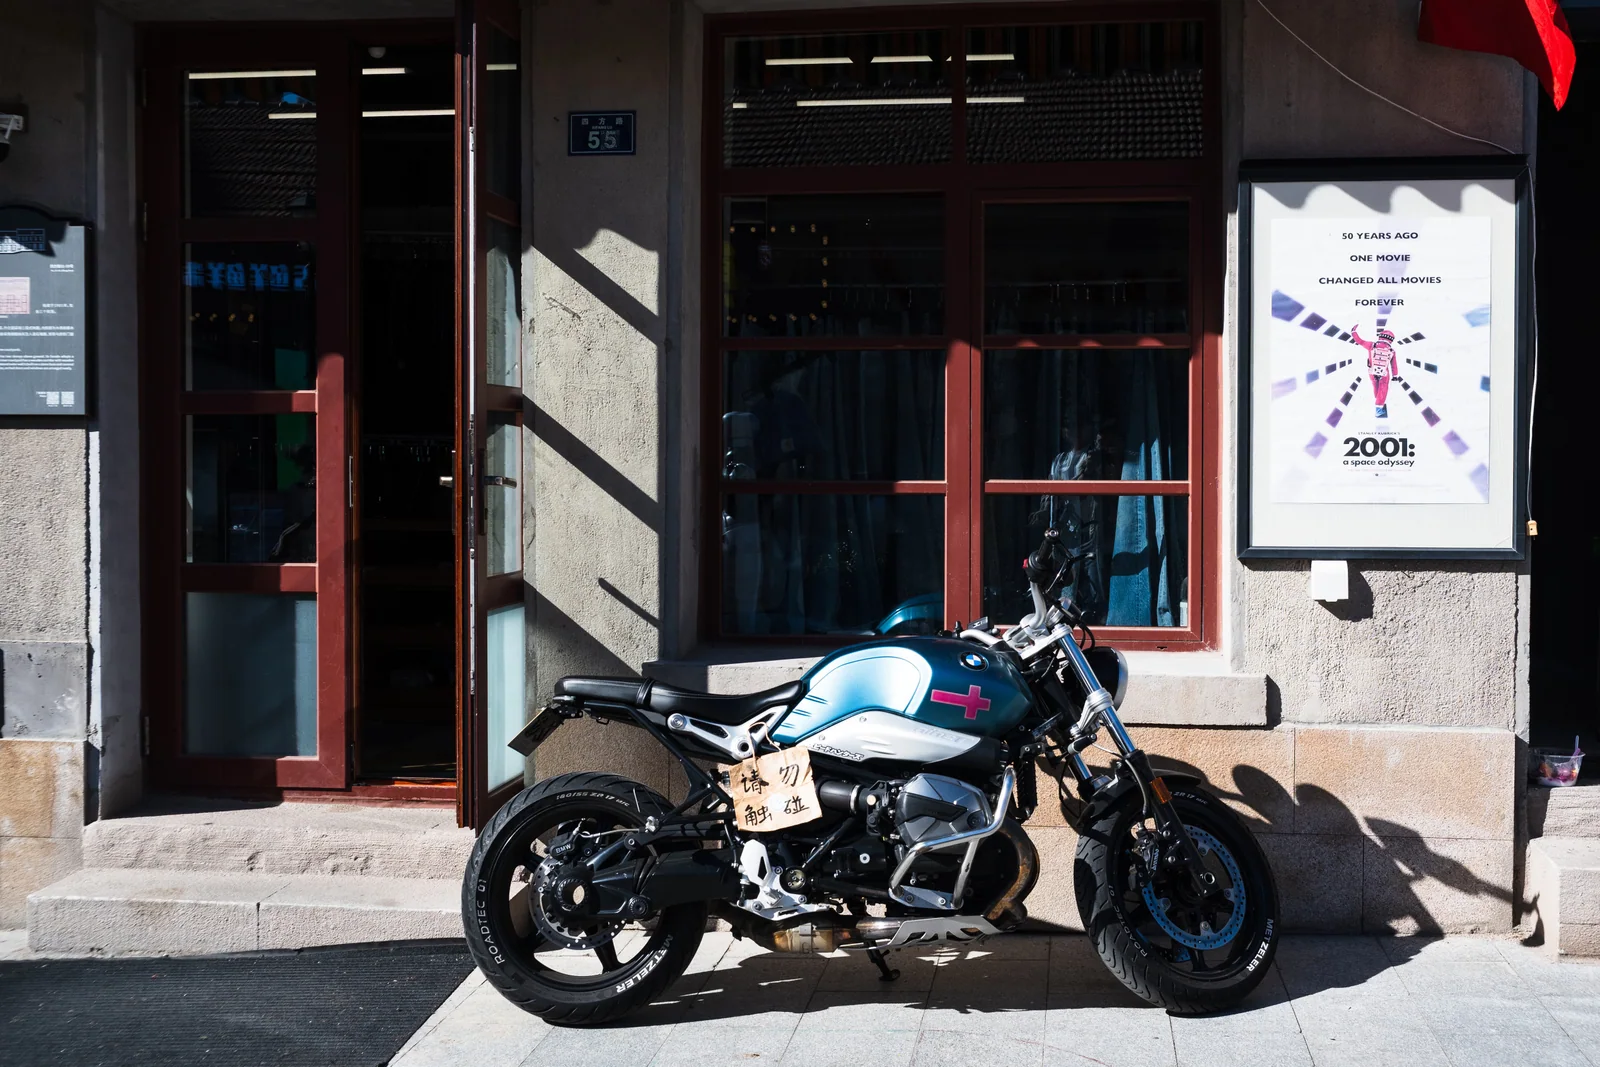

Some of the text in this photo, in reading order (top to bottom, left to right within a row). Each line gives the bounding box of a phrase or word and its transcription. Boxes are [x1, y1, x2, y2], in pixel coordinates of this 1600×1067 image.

[587, 131, 617, 149] 55
[1342, 232, 1419, 240] 50 YEARS AGO
[1349, 254, 1411, 262] ONE MOVIE
[1376, 276, 1398, 284] ALL
[1400, 276, 1442, 284] MOVIES
[1343, 436, 1416, 458] 2001:
[1350, 459, 1376, 467] space
[1377, 458, 1415, 467] odyssey
[740, 763, 800, 795] 请勿
[744, 795, 810, 827] 触碰
[555, 844, 571, 853] BMW
[476, 878, 506, 965] ROADTEC 01
[1113, 904, 1149, 958] ROADTEC
[1245, 917, 1275, 972] METZELER
[615, 933, 675, 994] METZELER
